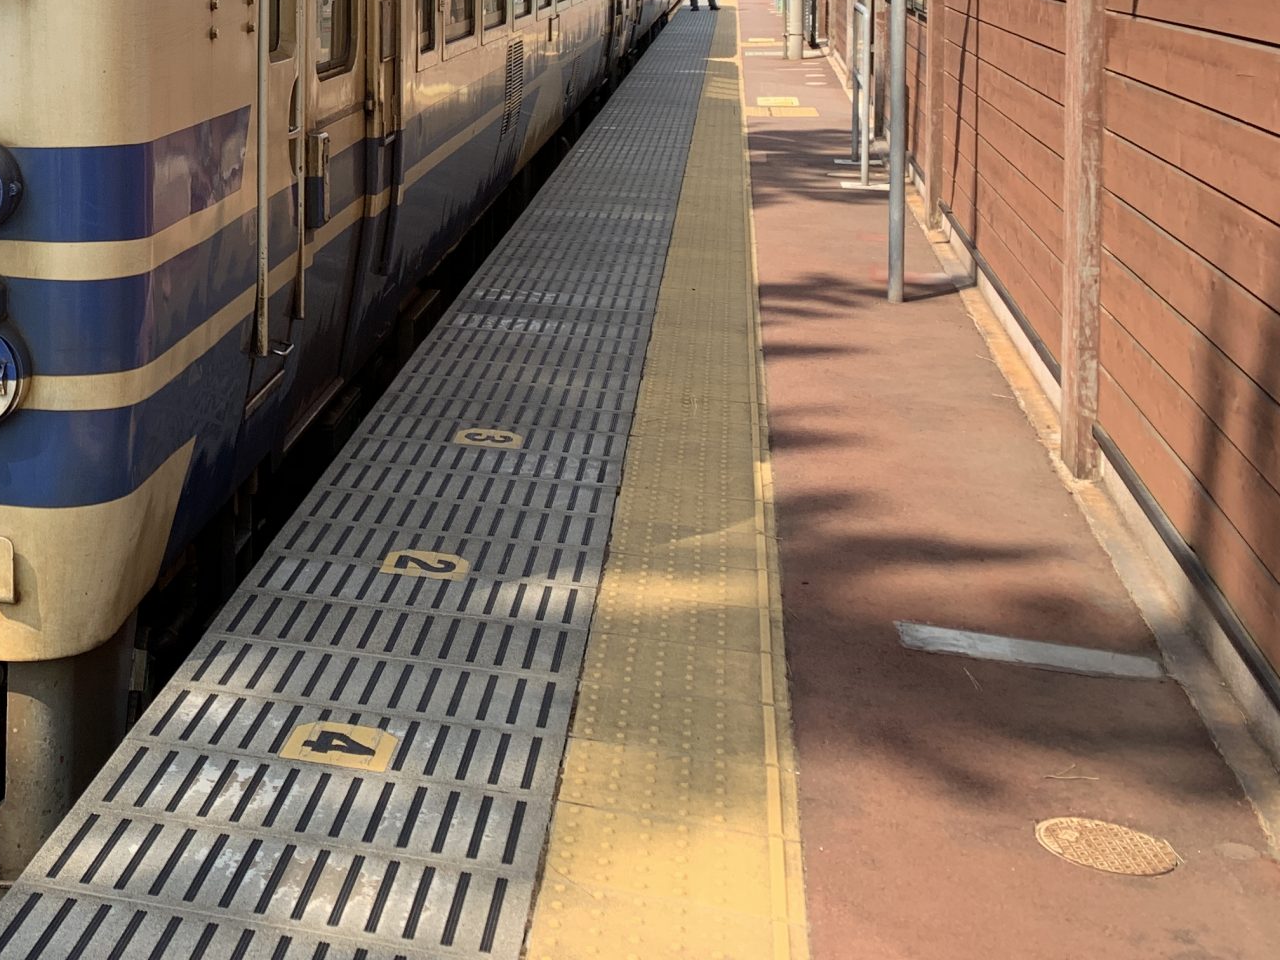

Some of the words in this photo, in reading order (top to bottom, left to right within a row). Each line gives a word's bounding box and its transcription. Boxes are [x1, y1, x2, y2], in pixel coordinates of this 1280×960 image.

[464, 432, 513, 444] 3
[394, 555, 456, 573] 2
[301, 730, 376, 757] 4
